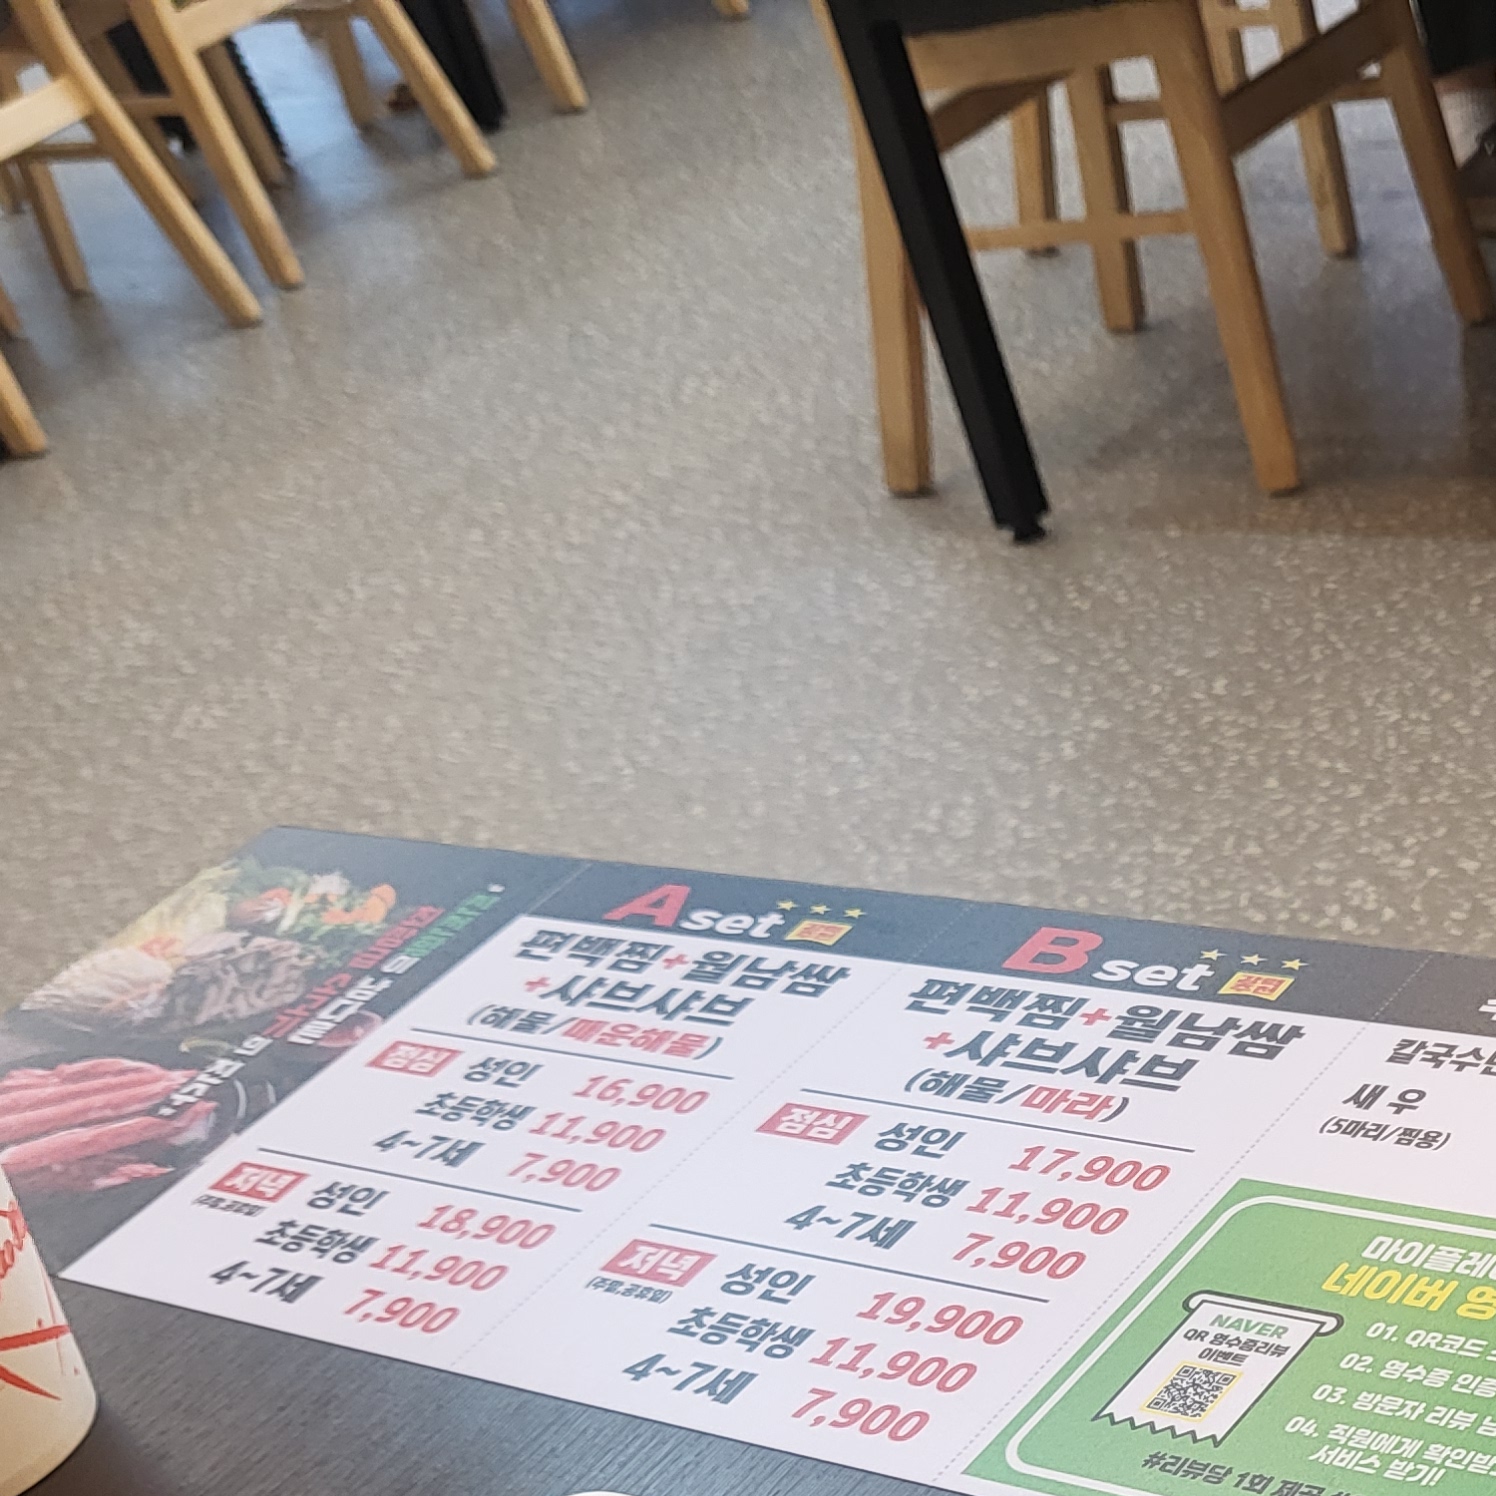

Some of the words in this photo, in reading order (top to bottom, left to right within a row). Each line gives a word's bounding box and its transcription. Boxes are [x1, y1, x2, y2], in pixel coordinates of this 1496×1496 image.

[602, 884, 691, 927] A
[679, 908, 785, 939] set
[1001, 926, 1104, 976] B
[1092, 956, 1215, 992] set
[463, 1057, 545, 1088] 성인
[572, 1075, 710, 1115] 16,900
[904, 1067, 1129, 1123] (해물/마라)
[414, 1091, 537, 1131] 초등학생
[529, 1112, 667, 1154] 11,900
[776, 1107, 854, 1141] 점심
[873, 1121, 967, 1160] 성인
[1008, 1145, 1172, 1192] 17,900
[1318, 1116, 1452, 1151] (5마리/찜용)
[373, 1129, 486, 1168] 4~7세
[508, 1152, 621, 1192] 7,900
[306, 1181, 390, 1216] 성인
[417, 1204, 556, 1250] 18,900
[825, 1161, 971, 1209] 초등학생
[965, 1186, 1131, 1236] 11,900
[255, 1219, 380, 1265] 초등학생
[369, 1244, 510, 1292] 11,900
[783, 1204, 917, 1250] 4~7세
[953, 1232, 1088, 1281] 7,900
[208, 1260, 326, 1304] 4~7세
[343, 1288, 461, 1334] 7,900
[617, 1244, 702, 1281] 저녁
[720, 1261, 816, 1306] 성인
[856, 1290, 1025, 1346] 19,900
[1322, 1262, 1457, 1311] 네이버
[666, 1306, 814, 1360] 초등학생
[810, 1336, 979, 1395] 11,900
[1183, 1328, 1210, 1342] QR
[1208, 1332, 1291, 1358] 영수증리뷰
[1209, 1314, 1289, 1339] NAVER
[1366, 1322, 1398, 1342] 01.
[1404, 1329, 1488, 1358] QR코드
[1198, 1347, 1249, 1367] 이벤트
[1339, 1353, 1373, 1373] 02.
[1379, 1359, 1453, 1388] 영수증
[621, 1353, 760, 1405] 4~7세
[790, 1387, 931, 1443] 7,900
[1312, 1384, 1347, 1405] 03.
[1352, 1391, 1426, 1421] 방문자
[1424, 1405, 1478, 1431] 리뷰
[1308, 1444, 1381, 1475] 서비스
[1382, 1459, 1447, 1487] 받기!
[1326, 1423, 1424, 1458] 직원에게
[1140, 1450, 1234, 1485] #리뷰당
[1233, 1471, 1275, 1495] 1회
